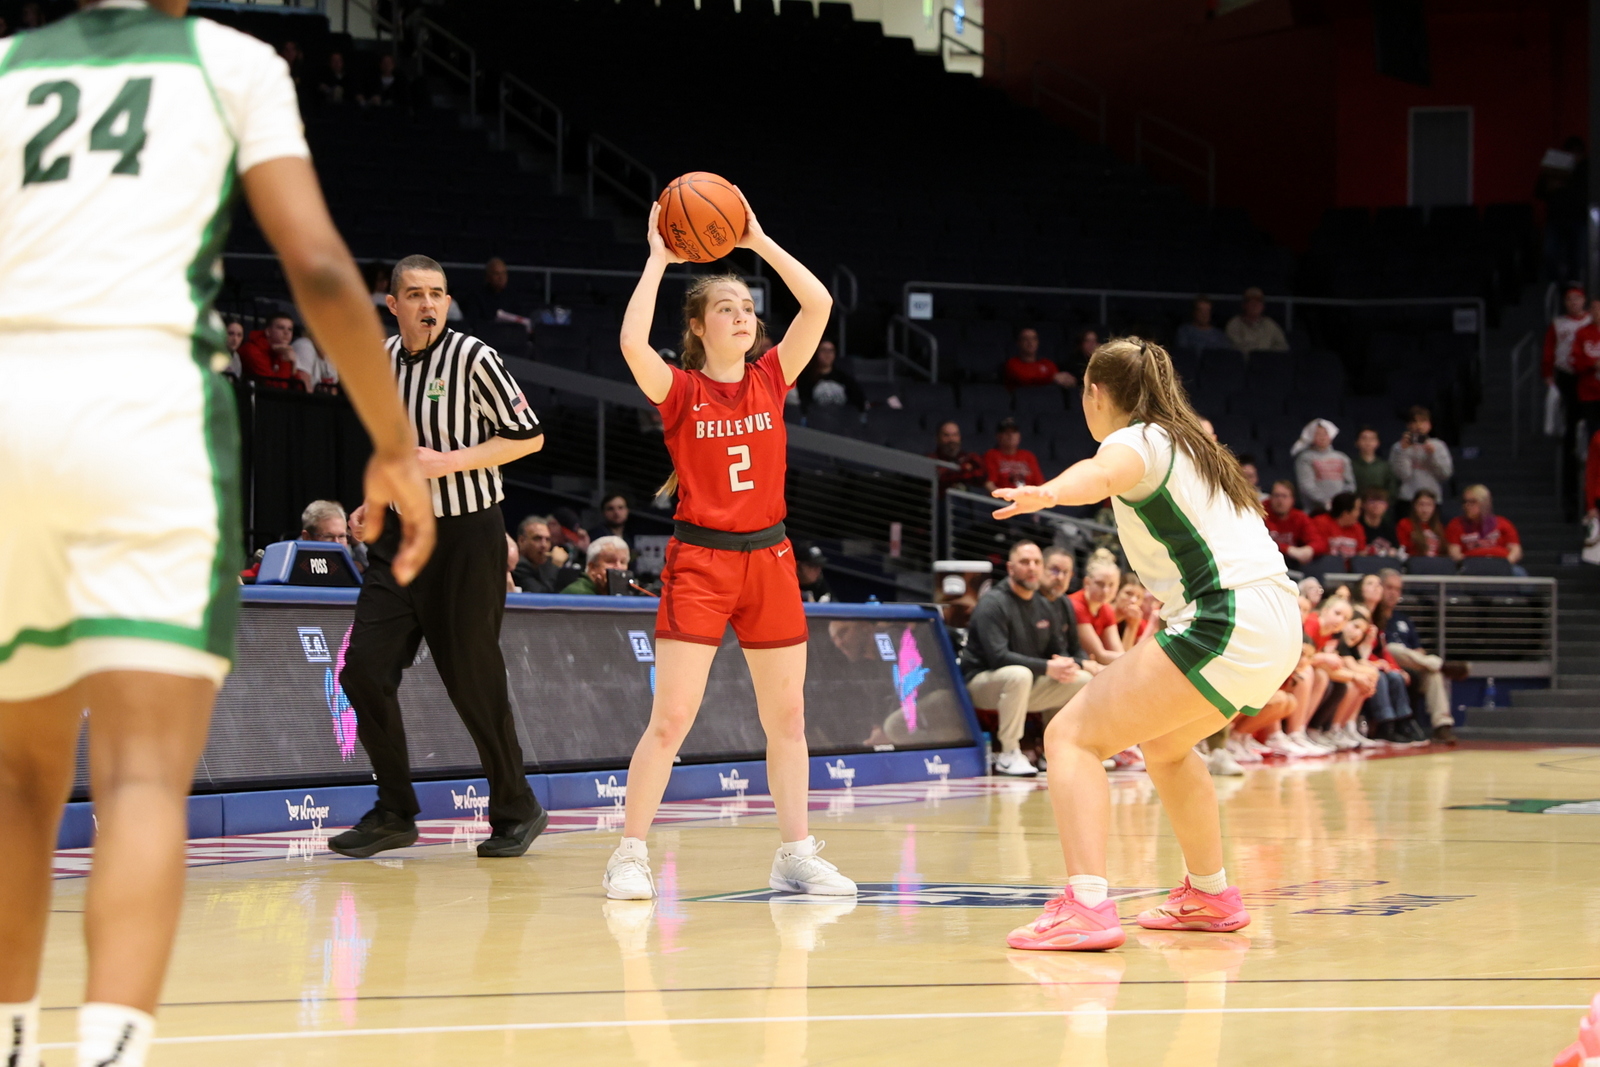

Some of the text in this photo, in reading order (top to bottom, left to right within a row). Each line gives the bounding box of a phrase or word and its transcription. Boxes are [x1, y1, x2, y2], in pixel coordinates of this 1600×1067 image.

[22, 77, 153, 188] 24
[696, 411, 773, 439] BELLEVUE
[727, 444, 755, 492] 2
[310, 558, 328, 574] POSS
[300, 794, 330, 829] Kroger
[1290, 893, 1477, 916] BANK
